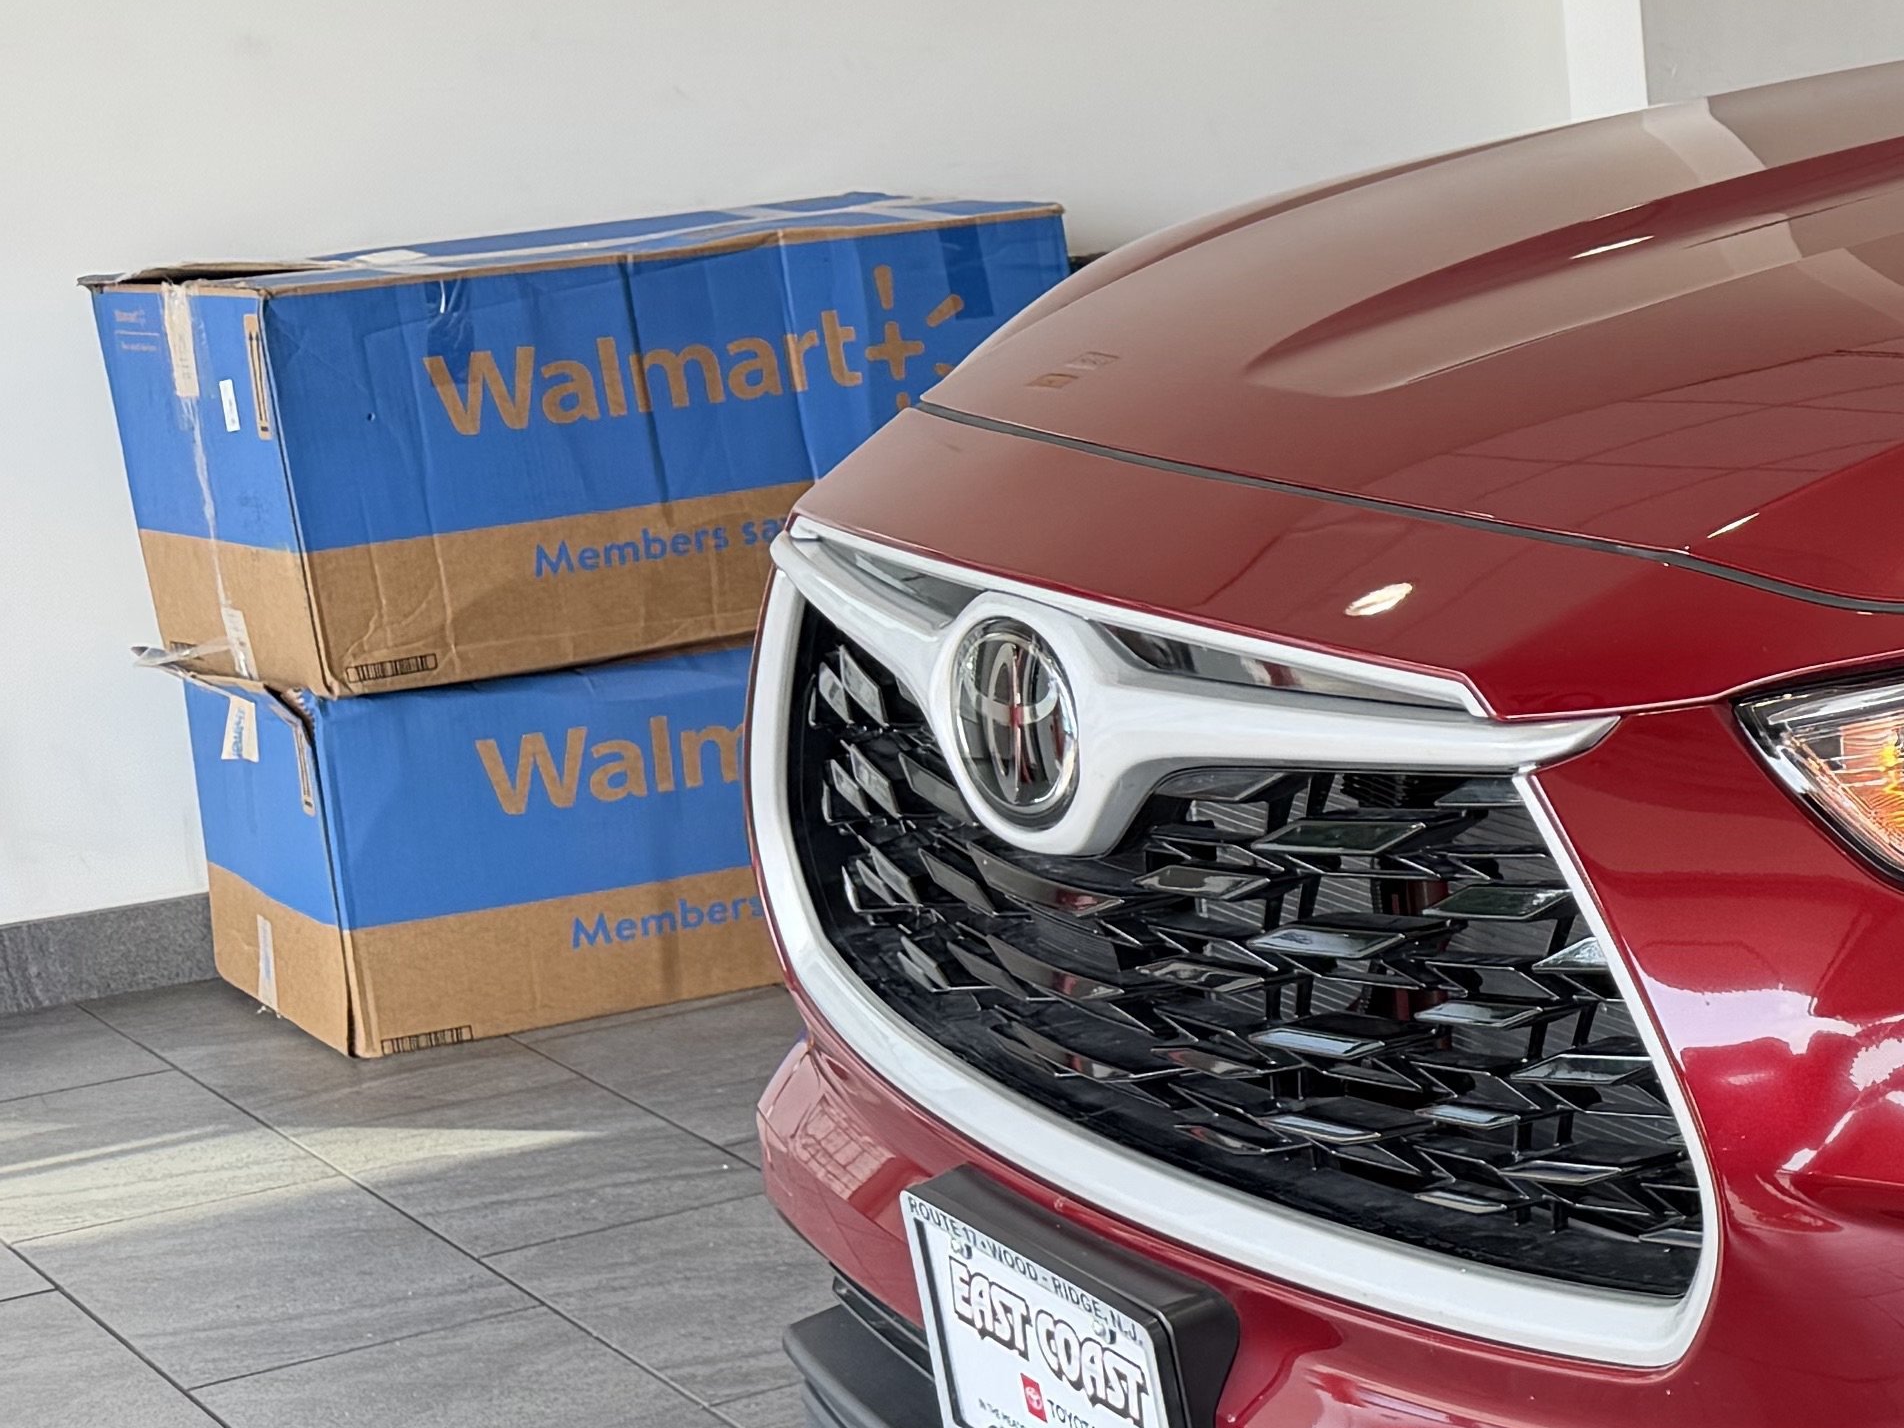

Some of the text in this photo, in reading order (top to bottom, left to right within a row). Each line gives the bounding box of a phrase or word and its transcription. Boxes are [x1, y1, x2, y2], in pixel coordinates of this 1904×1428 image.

[533, 526, 729, 578] Members
[475, 715, 746, 815] Walm
[908, 1196, 962, 1238] ROUTE
[988, 1243, 1039, 1282] WOOD
[949, 1256, 1149, 1428] EAST COAST
